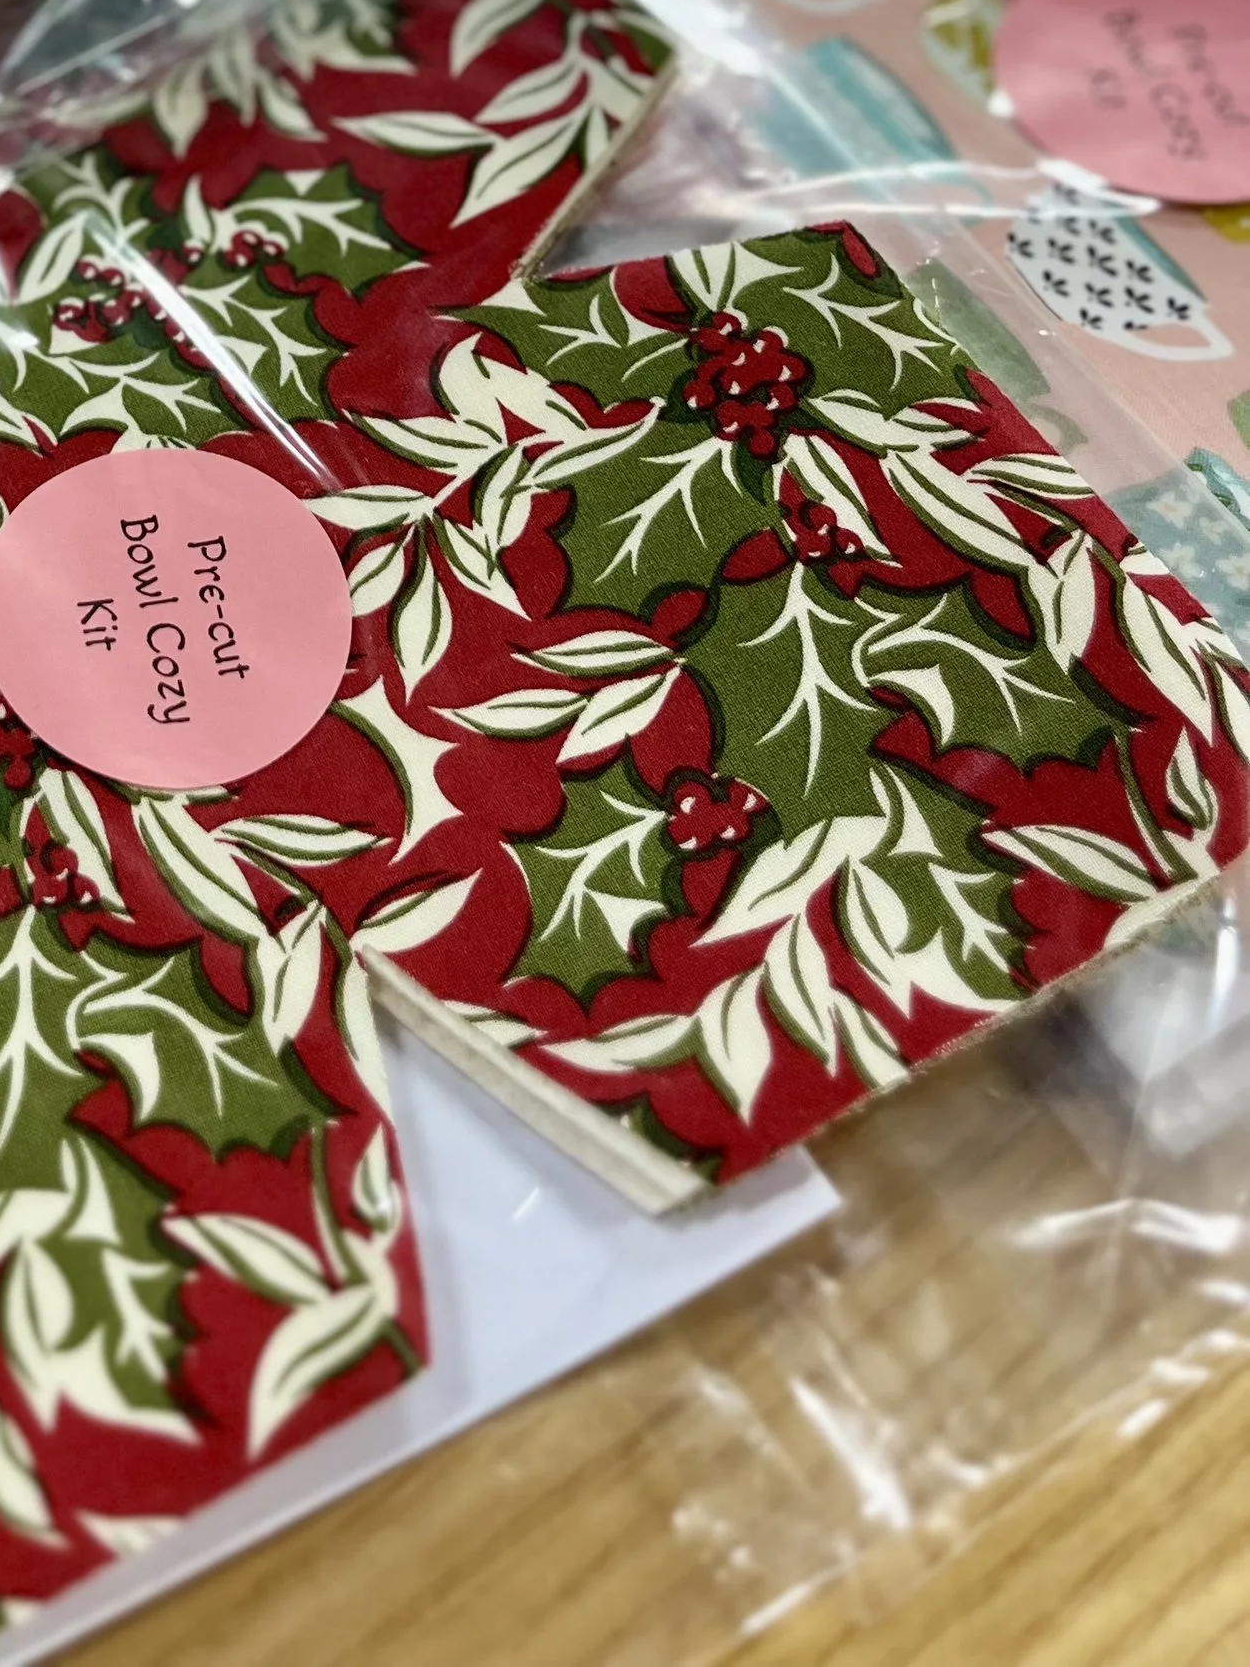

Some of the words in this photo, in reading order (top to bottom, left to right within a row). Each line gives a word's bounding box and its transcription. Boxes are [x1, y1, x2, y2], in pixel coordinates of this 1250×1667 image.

[121, 515, 178, 609] Bowl
[187, 536, 250, 679] Pre-cut
[77, 598, 119, 651] Kit
[147, 622, 190, 725] Cozy
